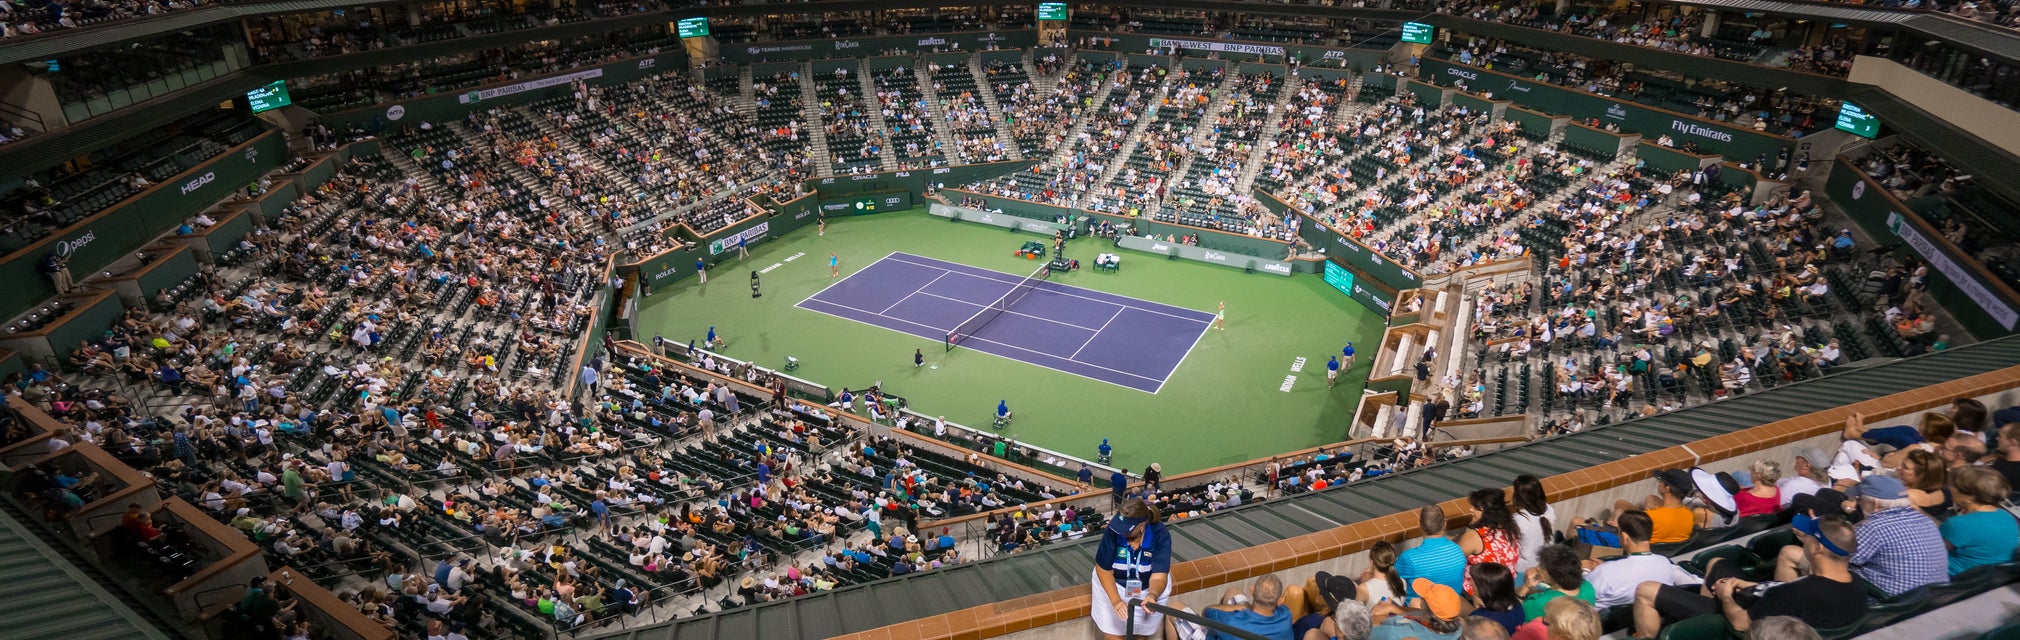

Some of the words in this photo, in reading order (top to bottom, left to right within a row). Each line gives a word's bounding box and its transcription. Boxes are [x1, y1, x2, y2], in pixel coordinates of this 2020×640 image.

[918, 36, 946, 46] LAVAZZA
[639, 58, 654, 66] ATP
[1448, 68, 1478, 80] ORACLE
[480, 90, 495, 99] BNP
[498, 84, 526, 95] PARIBAS
[1672, 120, 1688, 134] Fly
[1689, 124, 1732, 142] Emirates
[181, 171, 215, 195] HEAD
[71, 230, 95, 252] pepsi
[724, 236, 738, 247] BNP
[740, 224, 766, 240] PARIBAS
[655, 267, 677, 280] ROLEX
[1264, 263, 1289, 272] LAVAZZA
[1402, 269, 1414, 280] WTA
[1290, 356, 1306, 372] WELLS
